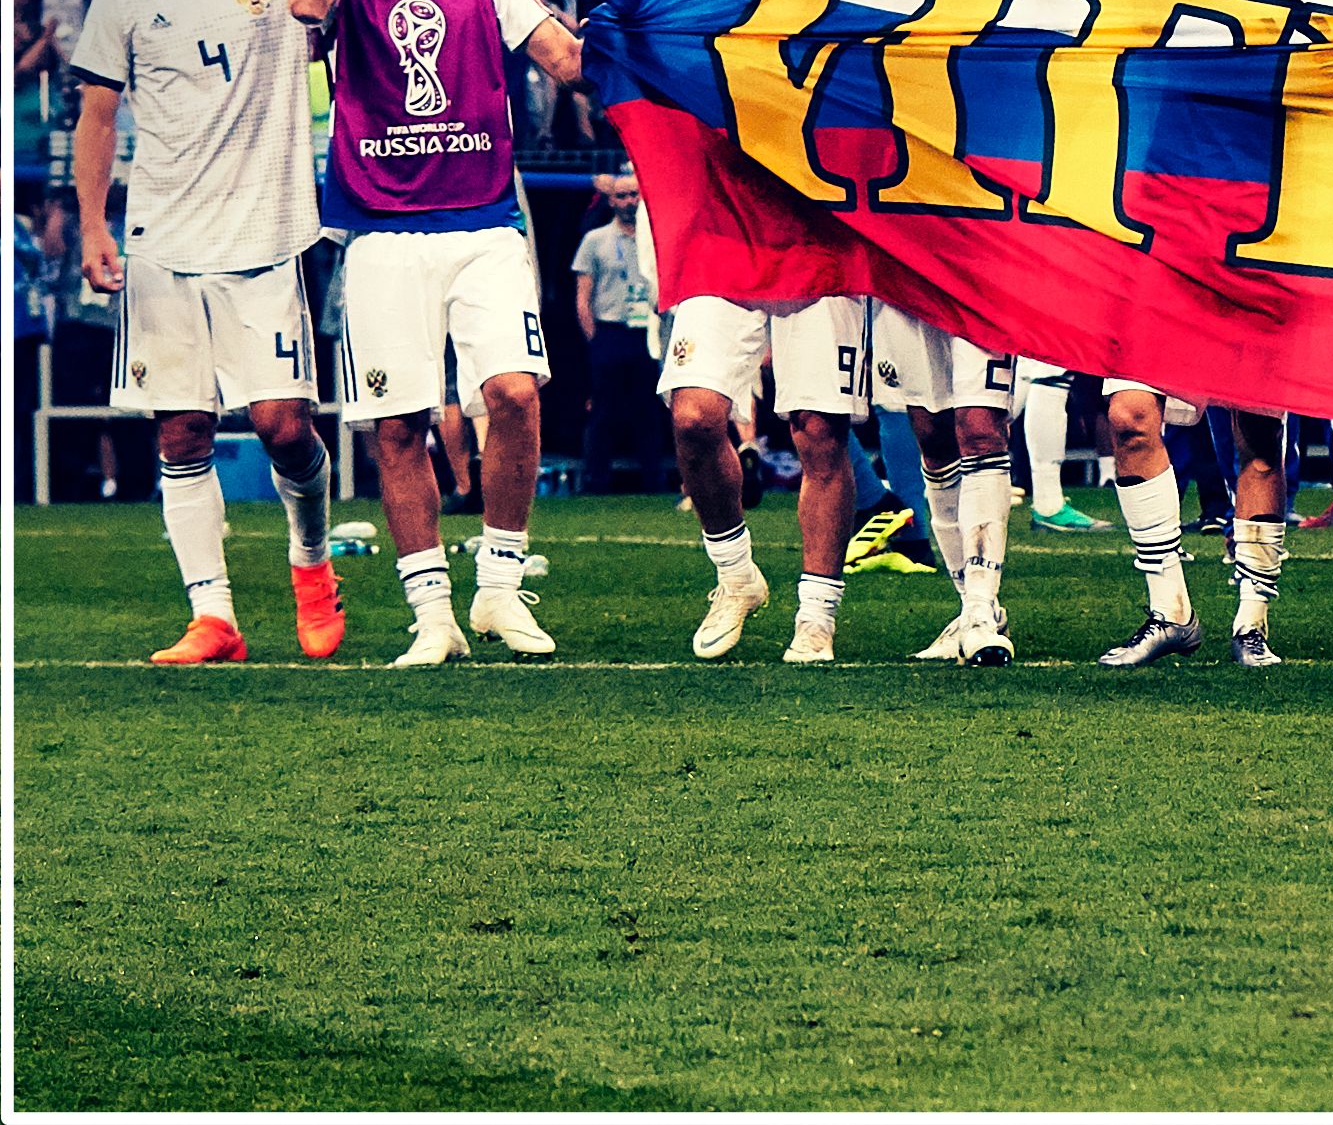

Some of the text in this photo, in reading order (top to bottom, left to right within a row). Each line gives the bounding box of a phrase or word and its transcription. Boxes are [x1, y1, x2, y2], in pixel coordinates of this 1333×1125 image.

[197, 39, 232, 83] 4
[359, 132, 493, 158] RUSSIA 2018
[386, 121, 466, 136] FIFA WORLD CUP
[275, 331, 300, 380] 4
[523, 310, 545, 358] 8
[838, 345, 857, 396] 9
